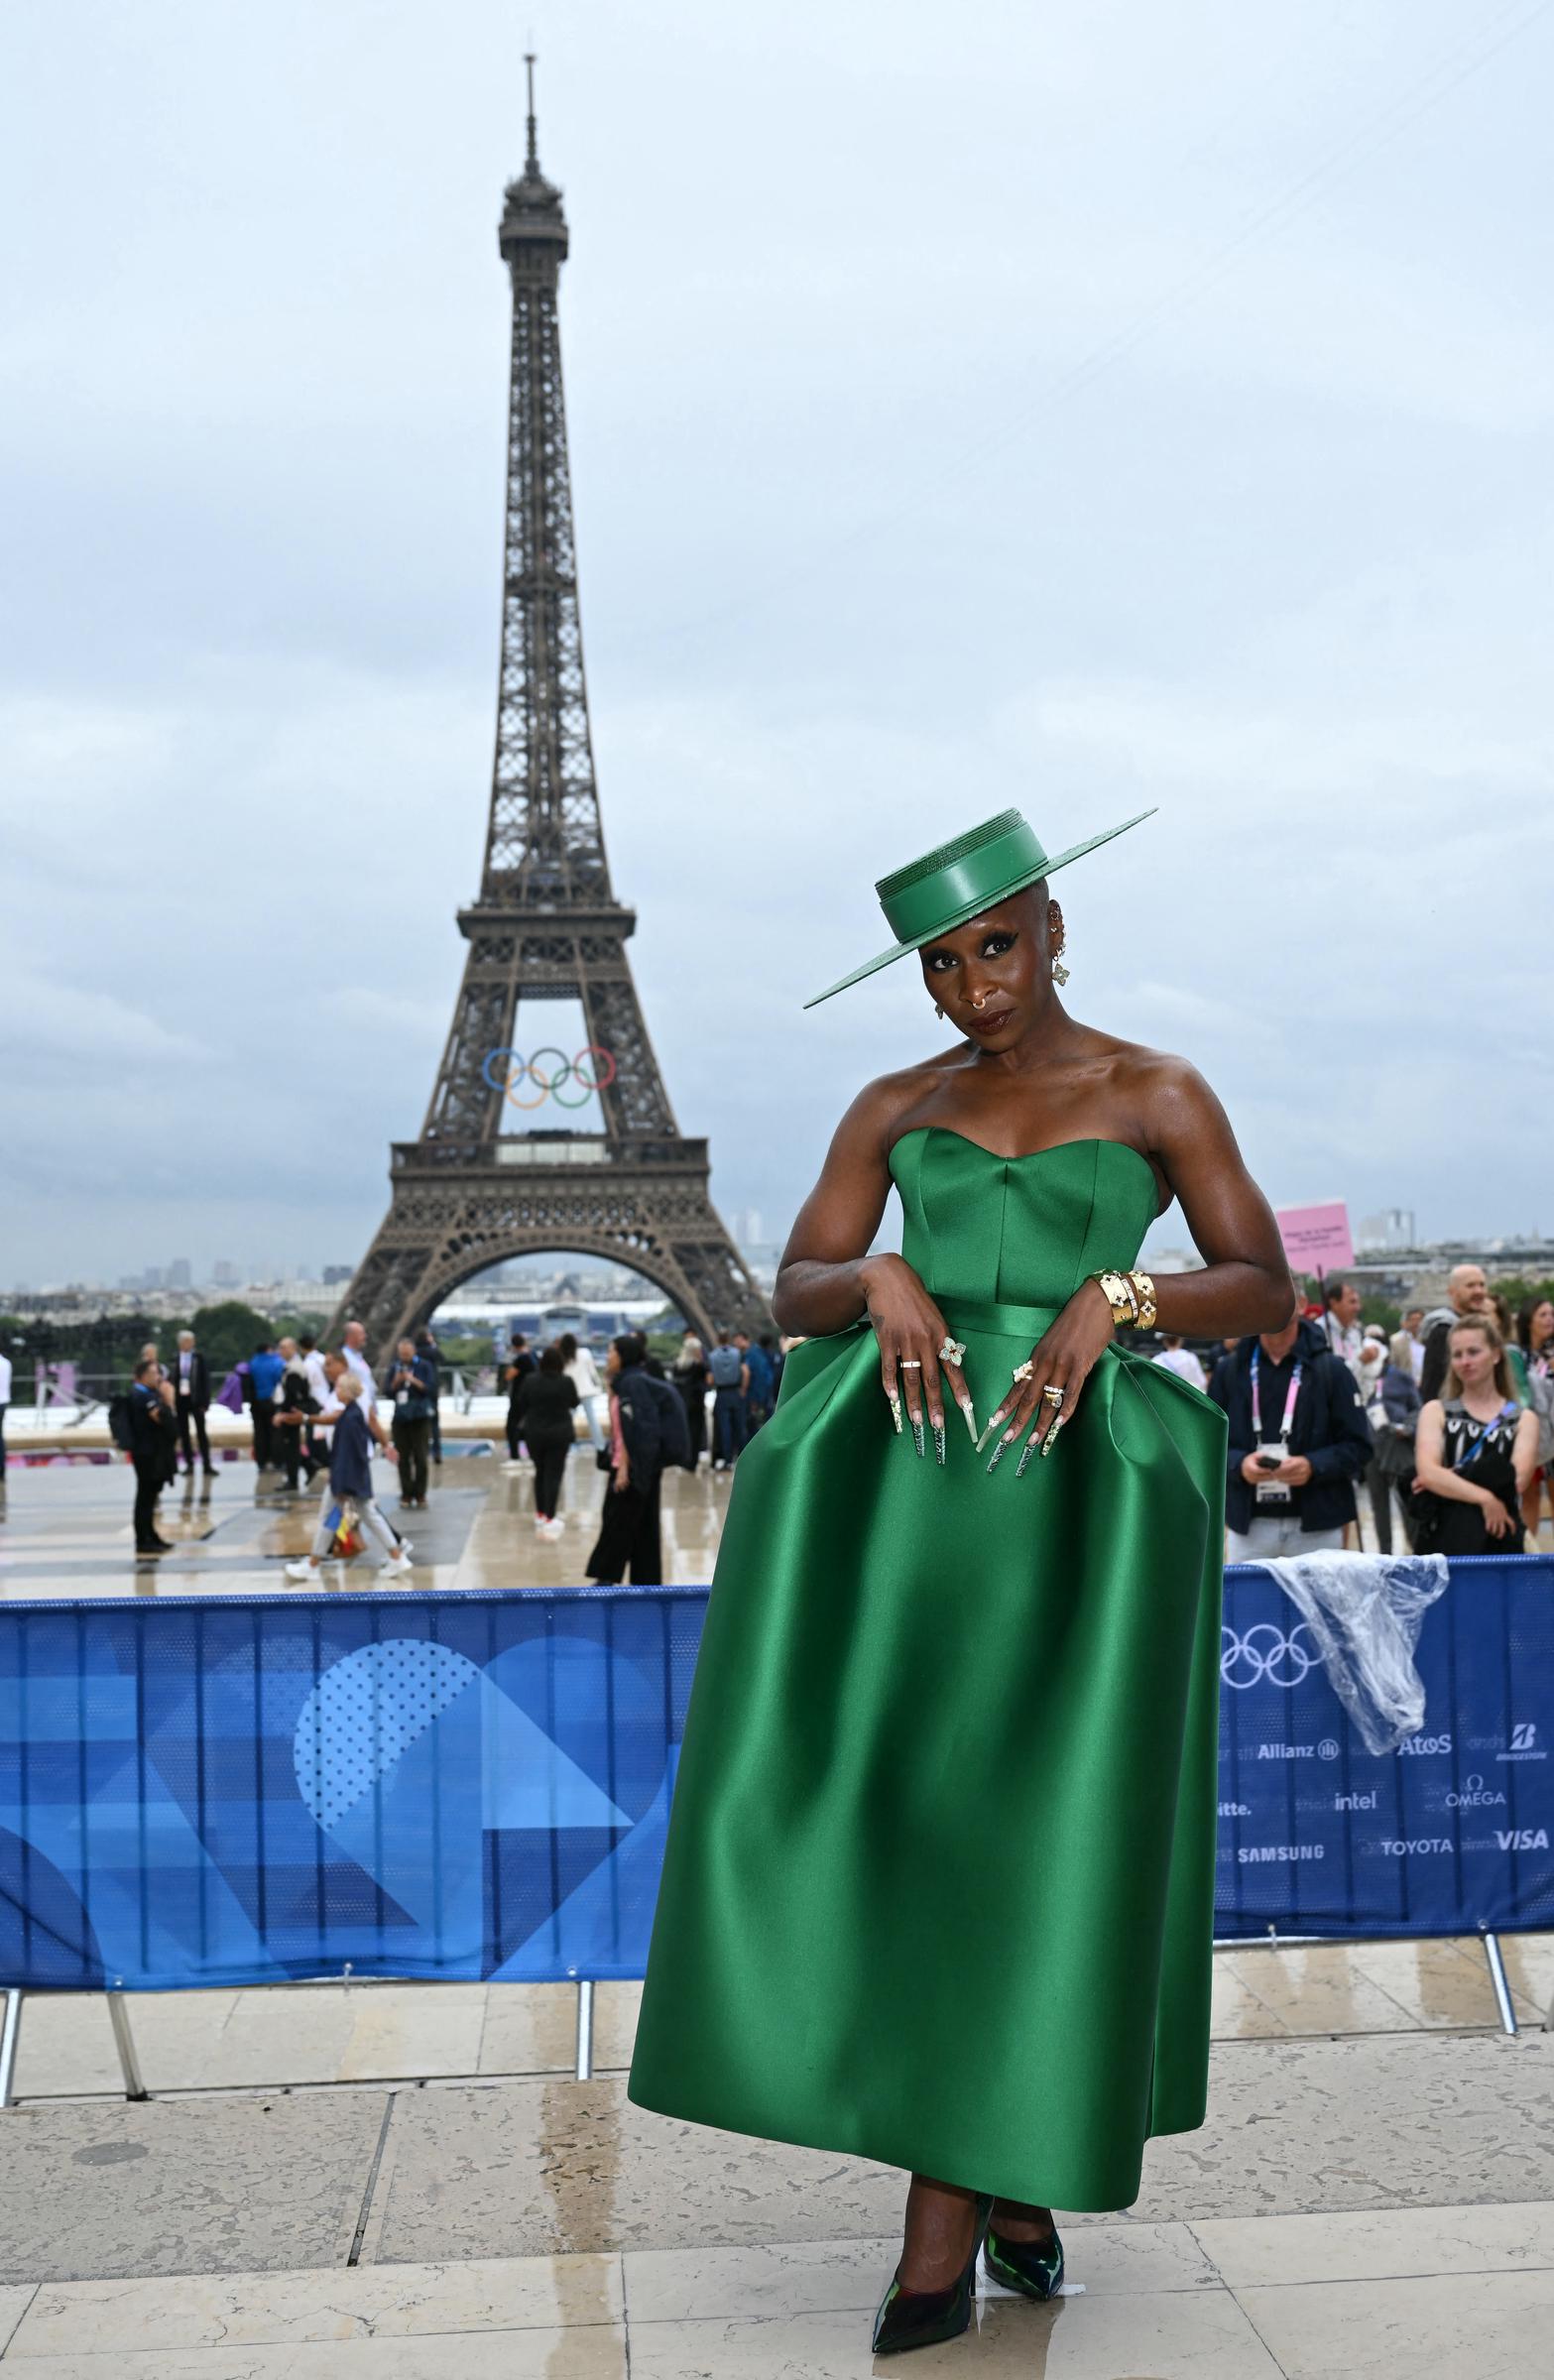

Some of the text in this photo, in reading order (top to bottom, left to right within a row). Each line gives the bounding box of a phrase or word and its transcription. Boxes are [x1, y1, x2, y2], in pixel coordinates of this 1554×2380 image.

[1257, 1742, 1314, 1759] Allianz
[1335, 1791, 1376, 1811] intel
[1445, 1791, 1506, 1807] OMEGA
[1381, 1839, 1454, 1855] TOYOTA
[1493, 1829, 1549, 1850] VISA
[1238, 1844, 1325, 1863] SAMSUNG
